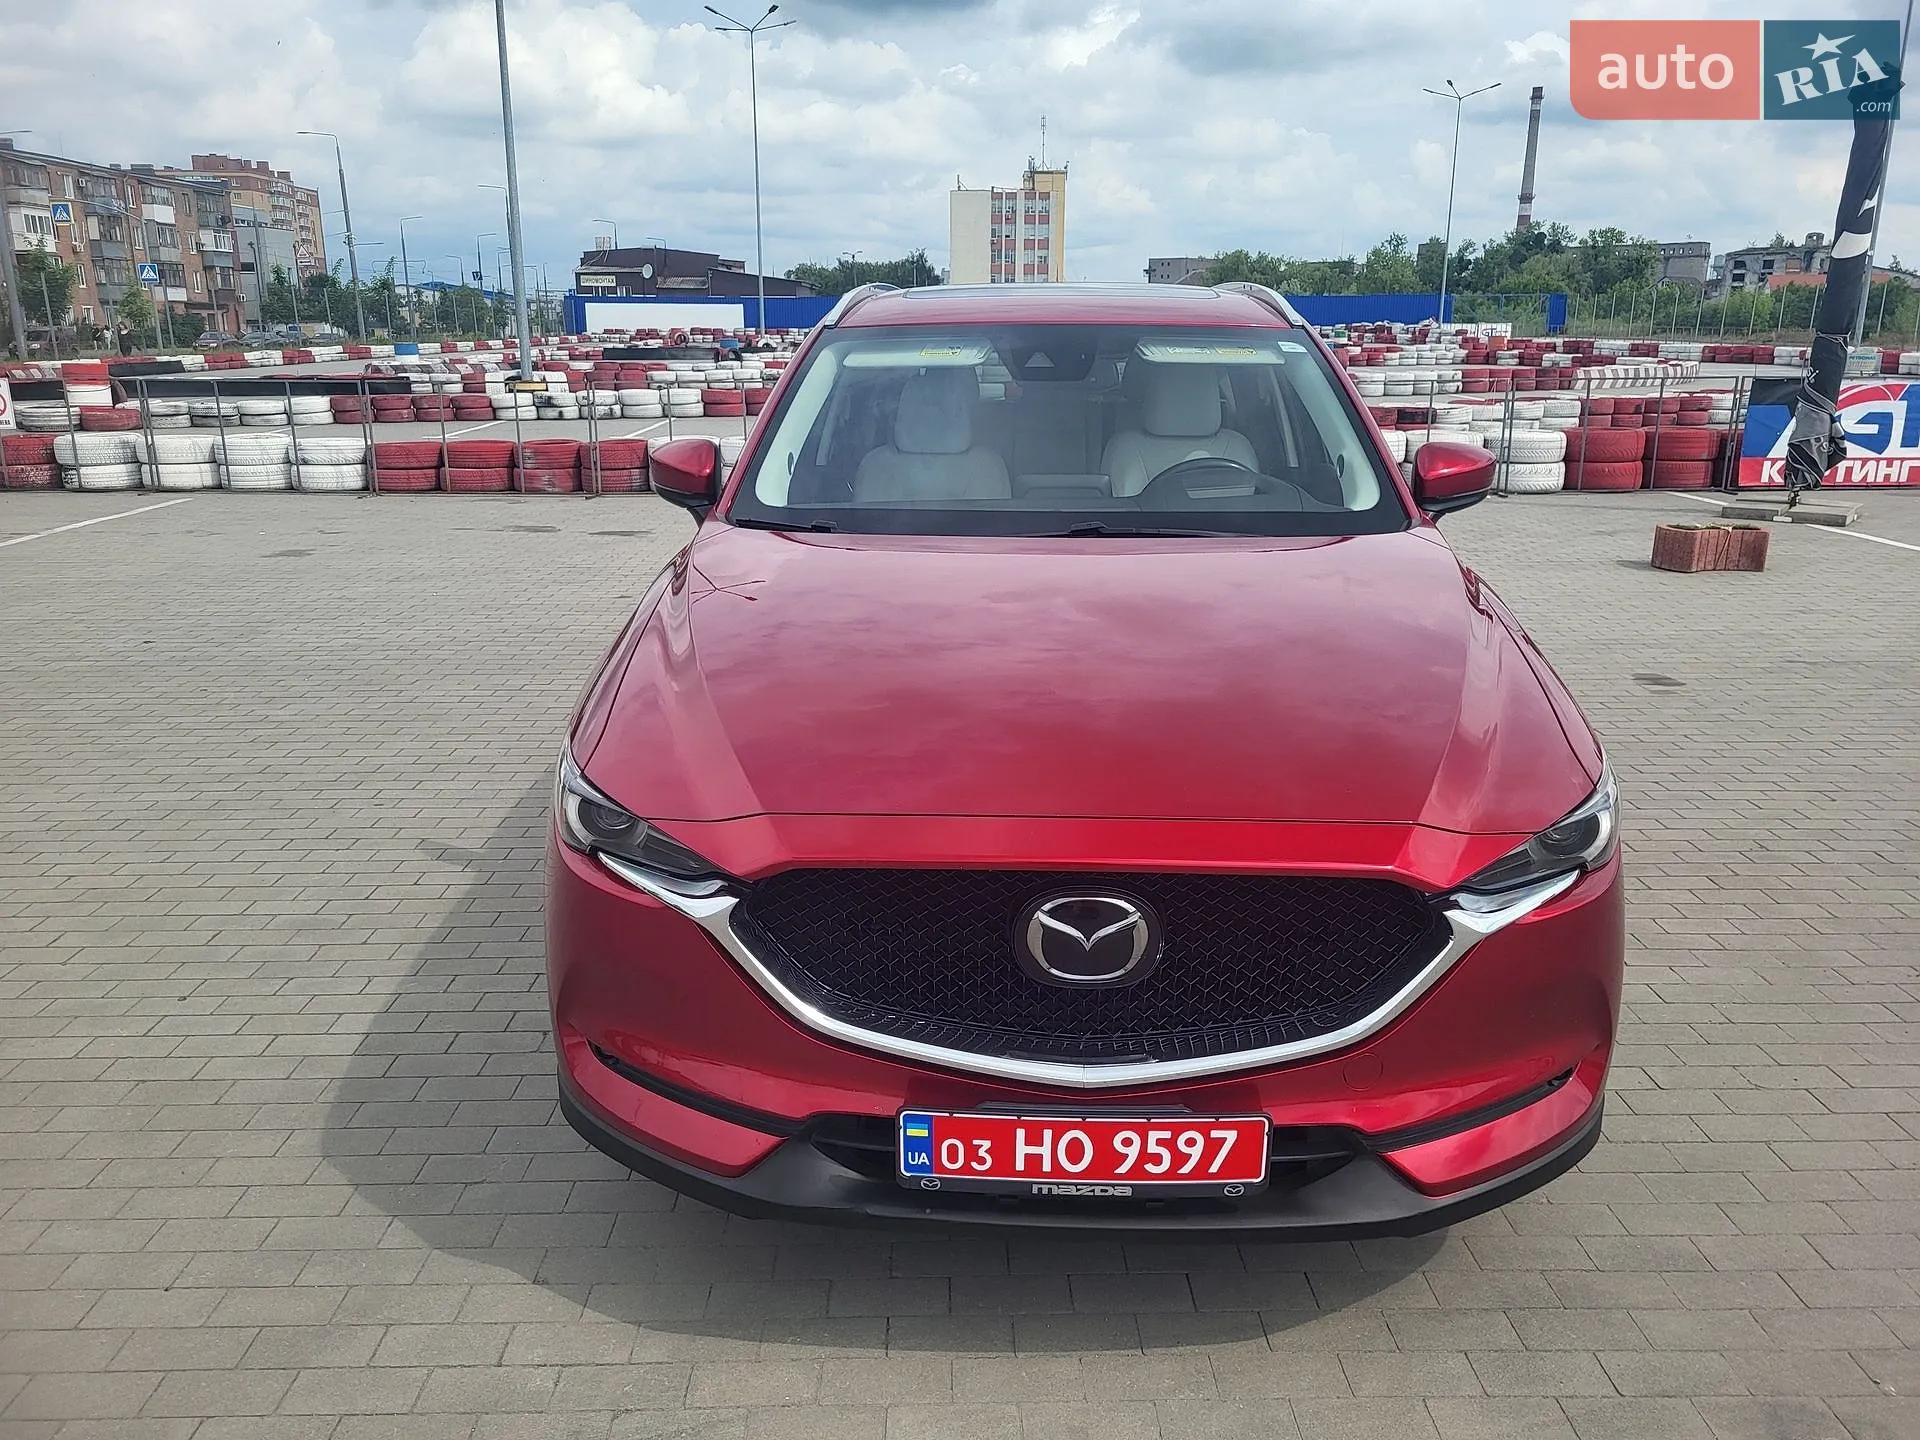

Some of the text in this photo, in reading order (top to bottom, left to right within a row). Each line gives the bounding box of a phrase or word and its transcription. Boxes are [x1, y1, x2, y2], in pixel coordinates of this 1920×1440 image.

[581, 276, 615, 285] ШИНОМОНТАЖ
[1761, 459, 1920, 484] КТИНГ
[908, 1127, 1239, 1175] UA 03 HO 9597
